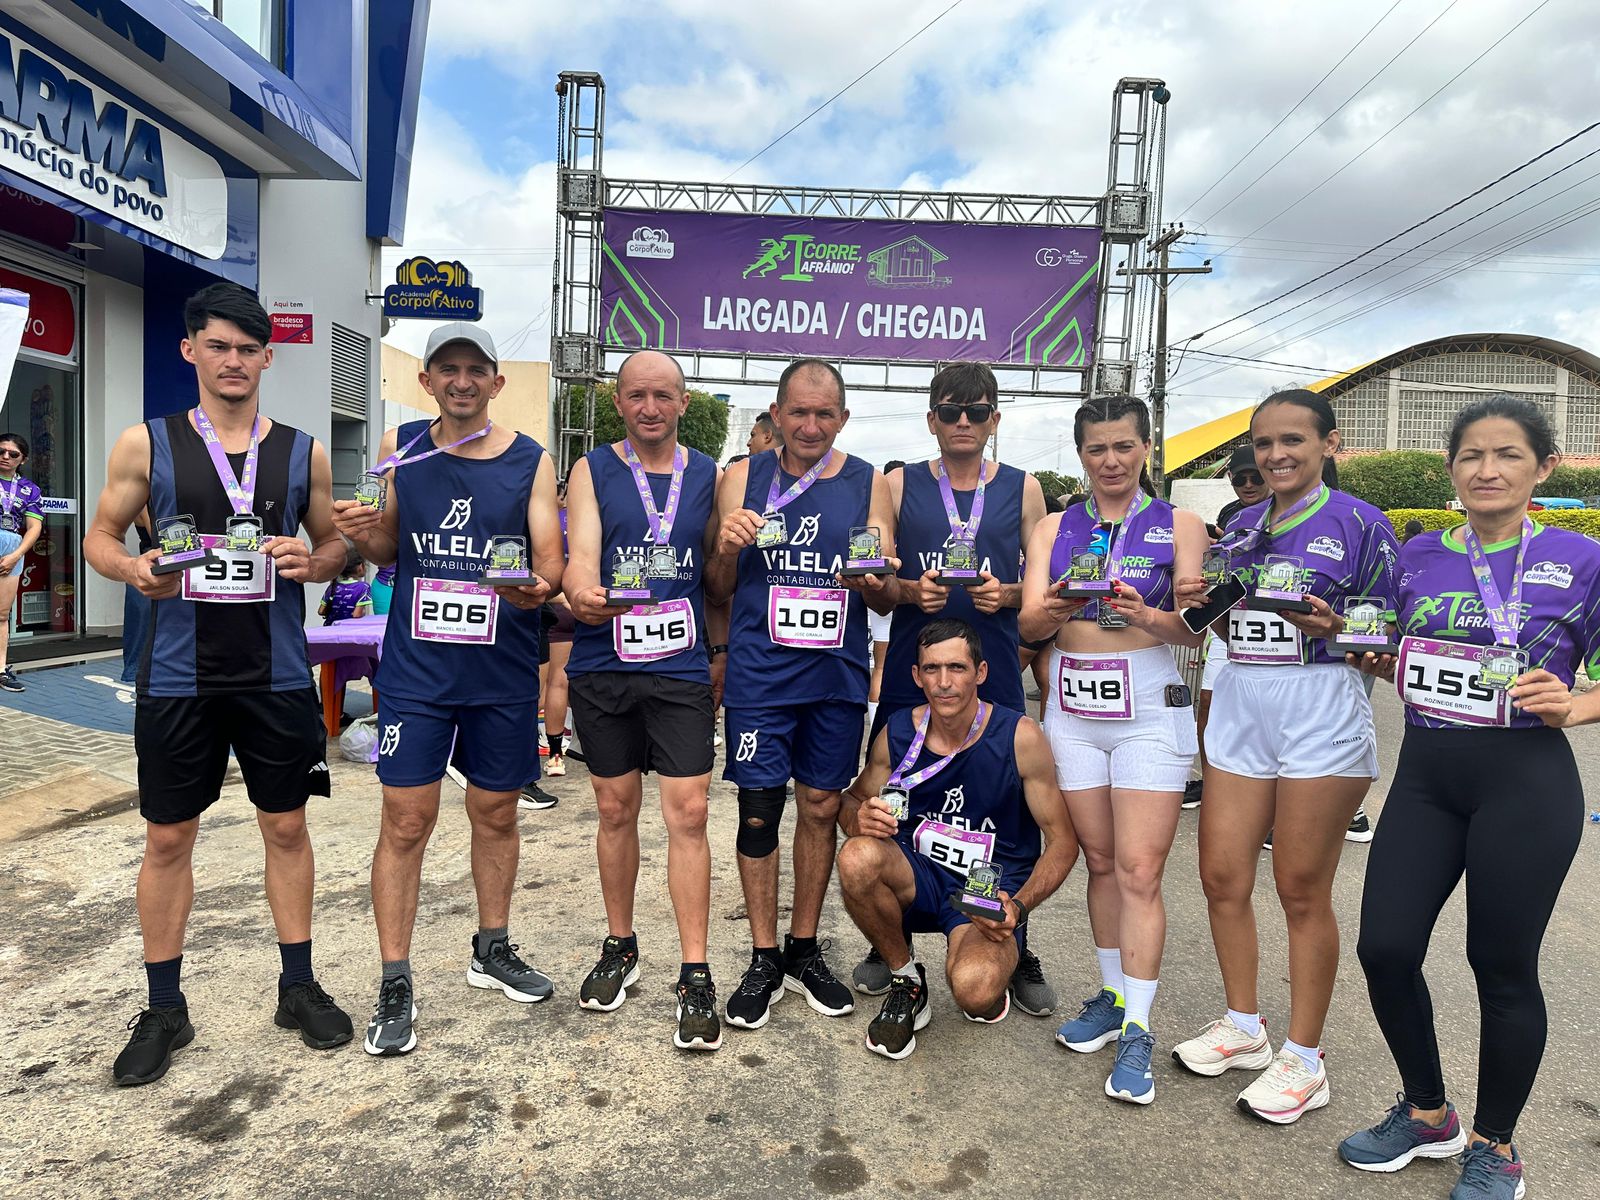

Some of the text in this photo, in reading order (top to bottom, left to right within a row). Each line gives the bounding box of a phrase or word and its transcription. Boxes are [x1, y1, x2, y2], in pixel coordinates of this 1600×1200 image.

[79, 163, 109, 195] do
[113, 183, 164, 222] povo
[803, 242, 862, 263] CORRE,
[800, 259, 855, 275] AFRÂNIO!
[389, 293, 431, 310] Corpo
[400, 290, 430, 298] Academia
[273, 301, 289, 309] Aqui
[273, 316, 304, 324] bradesco
[703, 296, 829, 335] LARGADA
[856, 302, 987, 341] CHEGADA
[42, 499, 69, 509] FARMA
[205, 560, 254, 581] 93
[417, 558, 492, 573] ONTABILIDAD
[1120, 567, 1152, 579] ÂNIO!
[421, 600, 488, 625] 206
[777, 607, 839, 629] 108
[623, 619, 686, 644] 146
[1231, 619, 1294, 643] 131
[1063, 676, 1122, 700] 148
[1454, 702, 1473, 711] BRITO
[929, 841, 969, 869] 51
